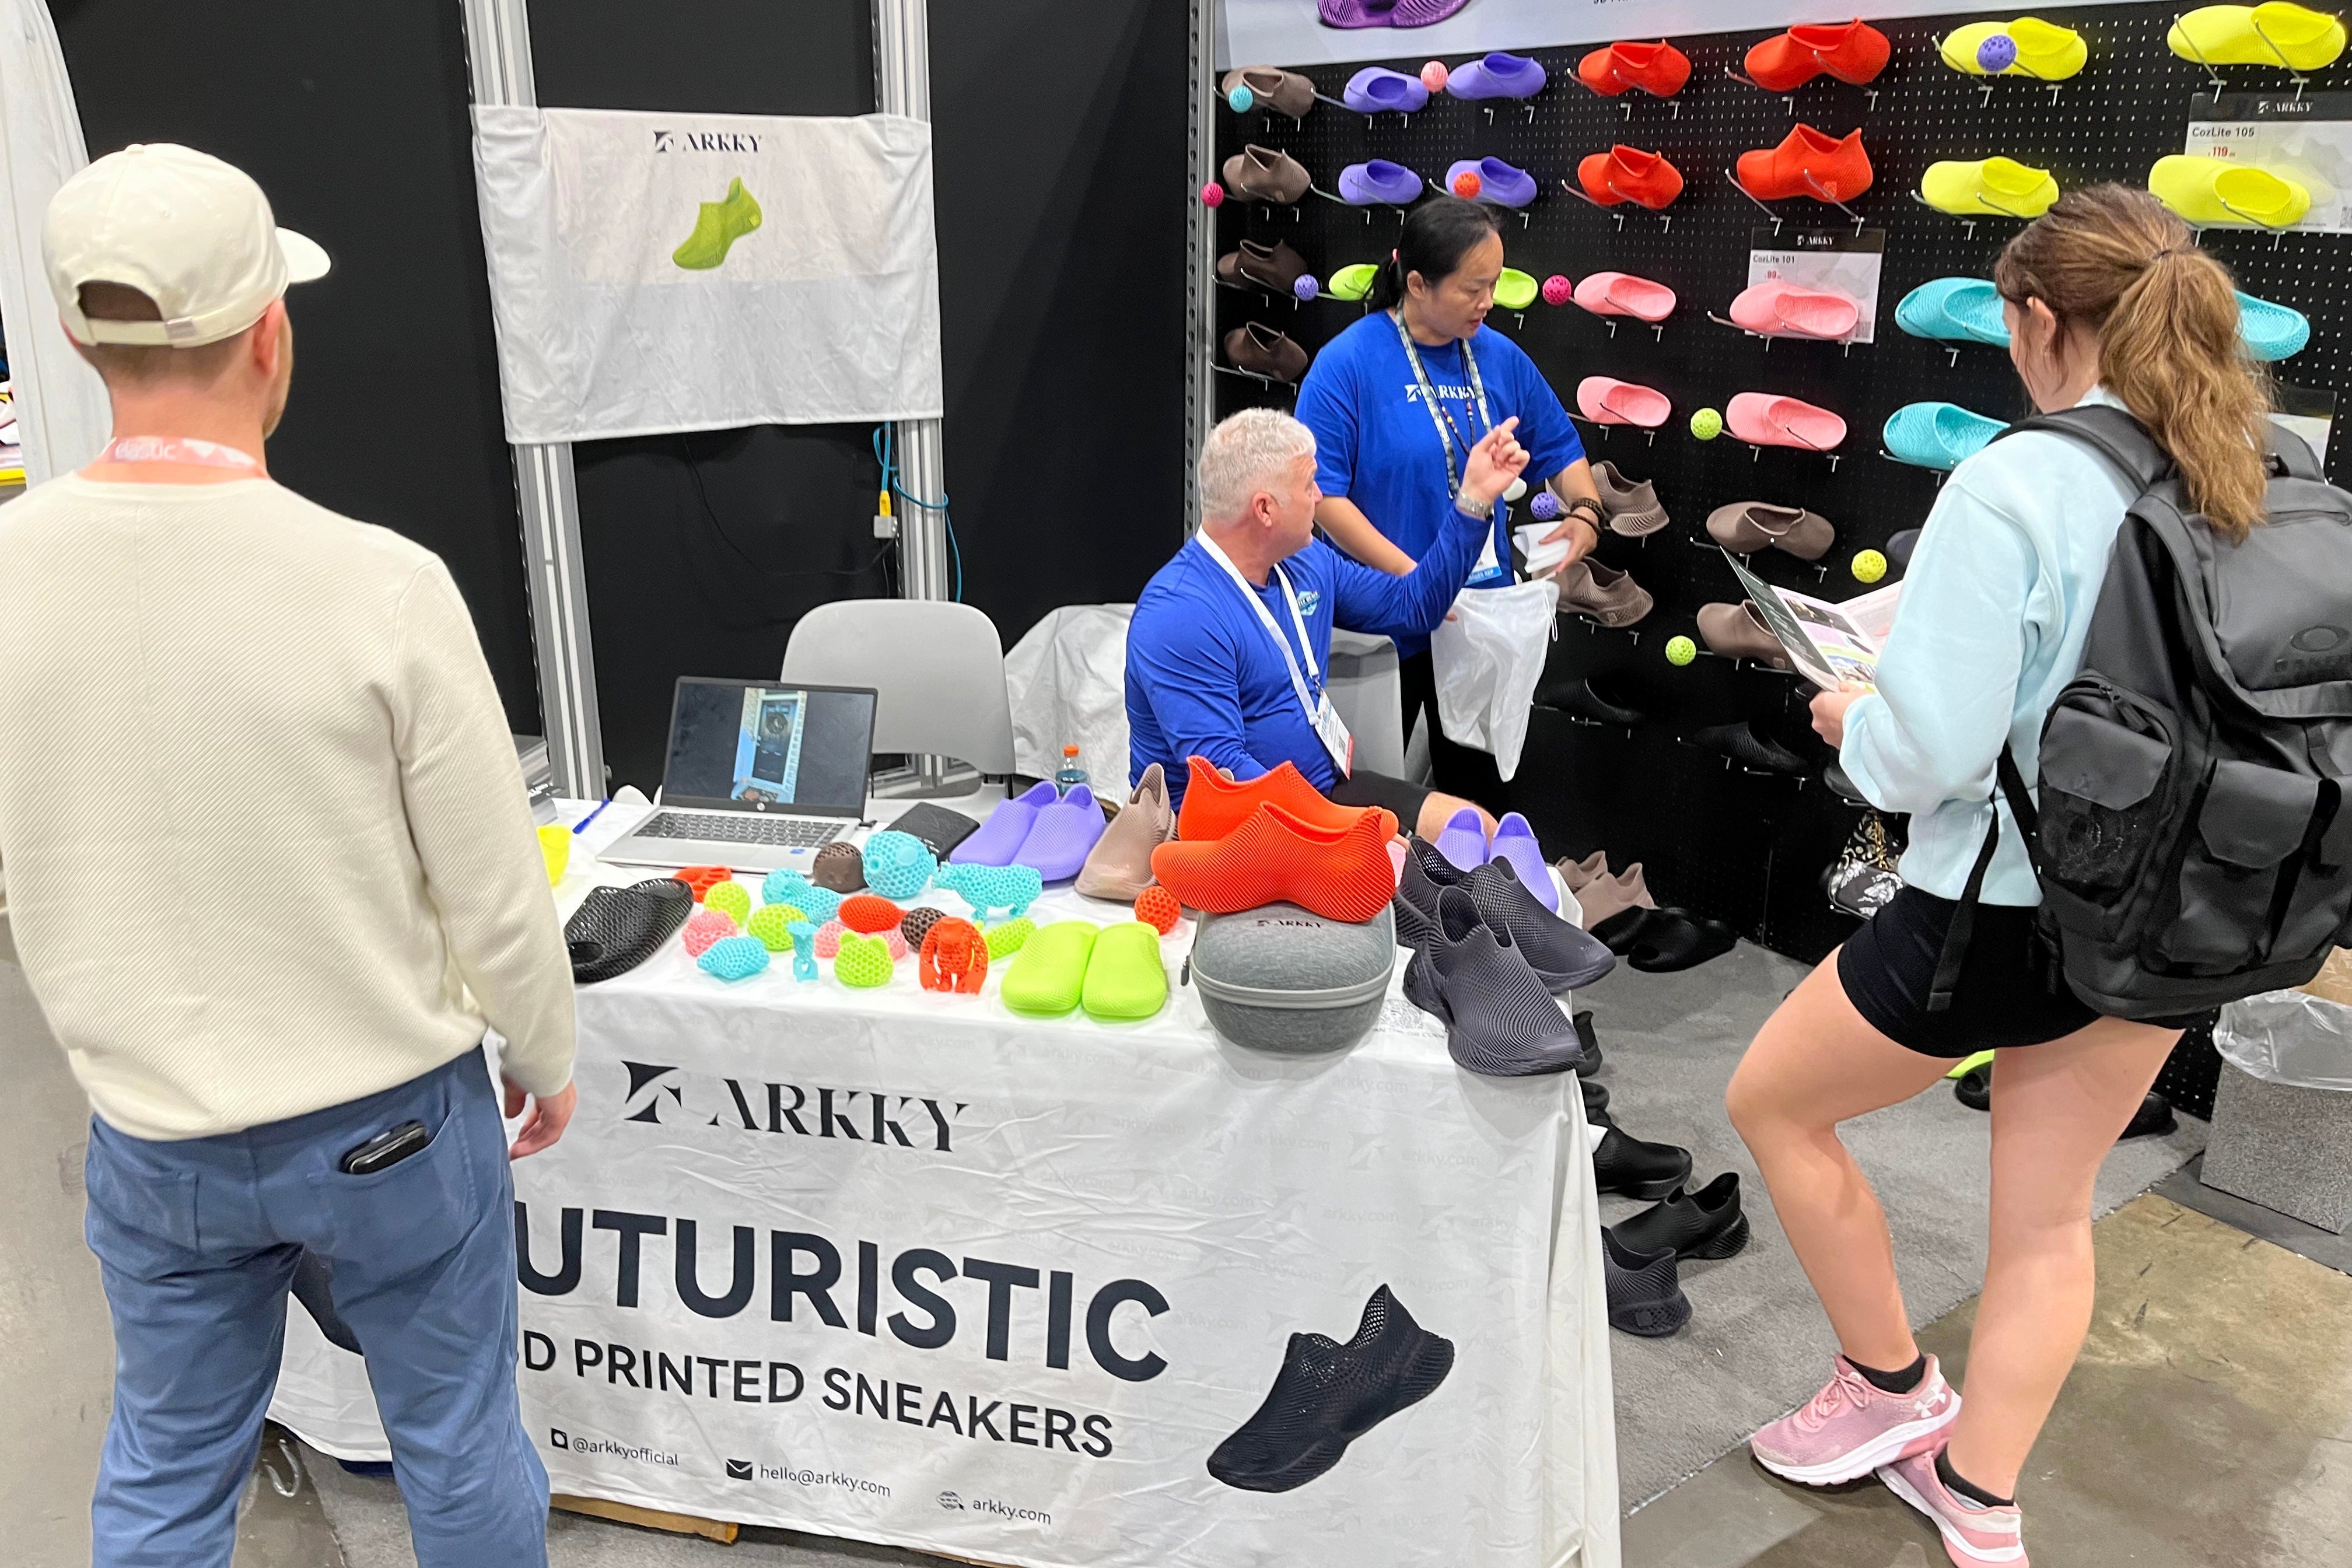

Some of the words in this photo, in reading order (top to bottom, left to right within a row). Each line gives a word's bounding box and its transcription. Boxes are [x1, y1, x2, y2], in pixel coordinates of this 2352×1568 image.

[2272, 101, 2314, 113] ARKKY
[682, 131, 762, 153] ARKKY
[2192, 127, 2231, 137] CozLite
[708, 1077, 970, 1153] ARKKY
[514, 1200, 1170, 1382] UTURISTIC
[517, 1330, 556, 1371] D
[575, 1339, 804, 1403] PRINTED
[822, 1368, 1113, 1458] SNEAKERS
[572, 1437, 679, 1466] @arkkyofficial
[760, 1464, 891, 1497] hello@arkky.com
[972, 1499, 1051, 1525] arkky.com
